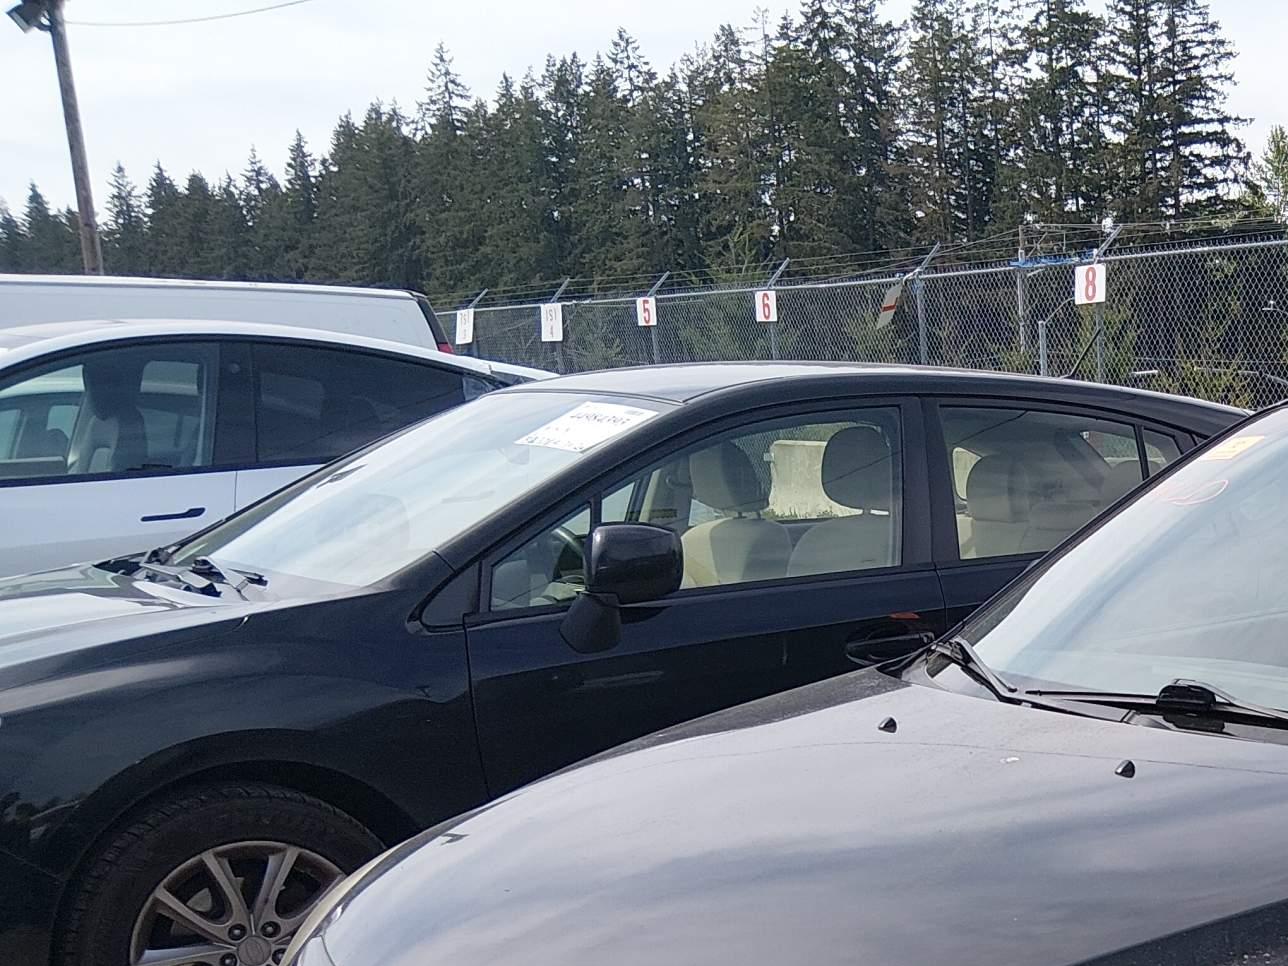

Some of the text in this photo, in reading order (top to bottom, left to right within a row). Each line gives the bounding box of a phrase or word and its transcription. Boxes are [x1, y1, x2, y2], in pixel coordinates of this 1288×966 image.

[1084, 266, 1097, 302] 8
[642, 299, 651, 324] 5
[761, 292, 771, 321] 6
